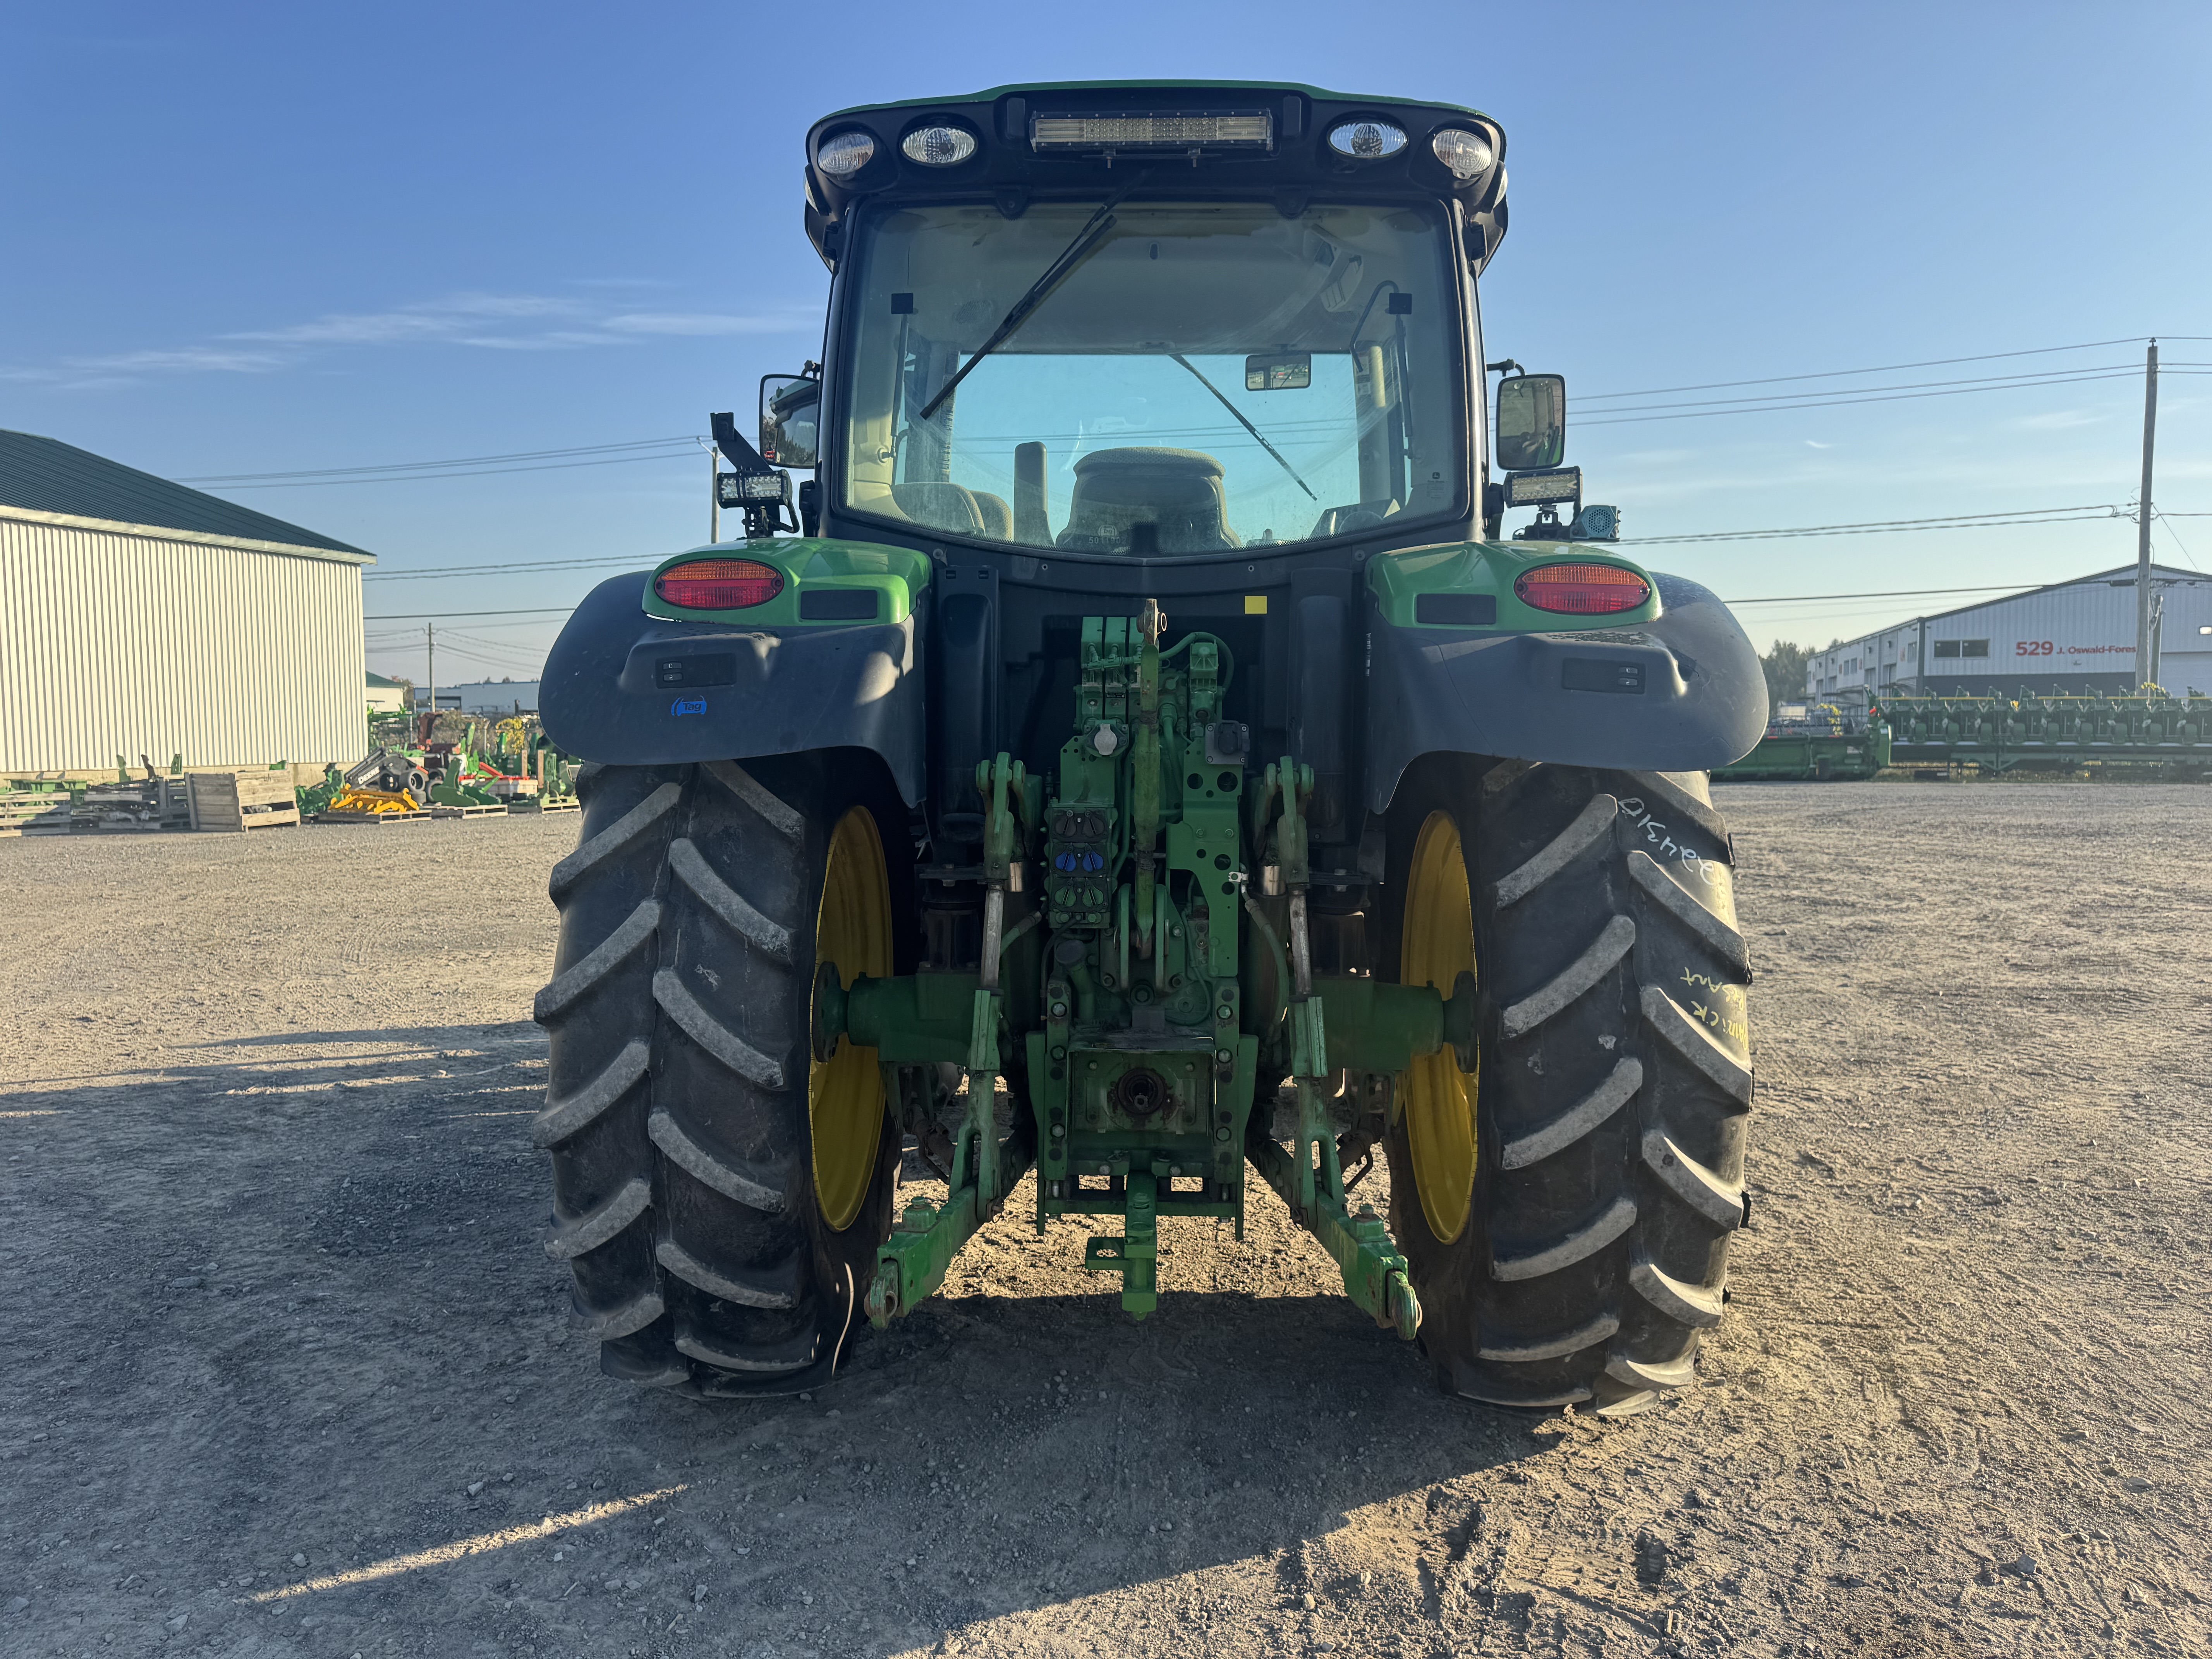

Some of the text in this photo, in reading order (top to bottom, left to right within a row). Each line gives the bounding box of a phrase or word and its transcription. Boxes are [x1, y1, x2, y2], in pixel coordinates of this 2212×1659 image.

[2016, 641, 2053, 656] 529
[2068, 646, 2136, 654] Oswald-Fores
[683, 702, 701, 711] Tag
[358, 766, 380, 785] DEERE
